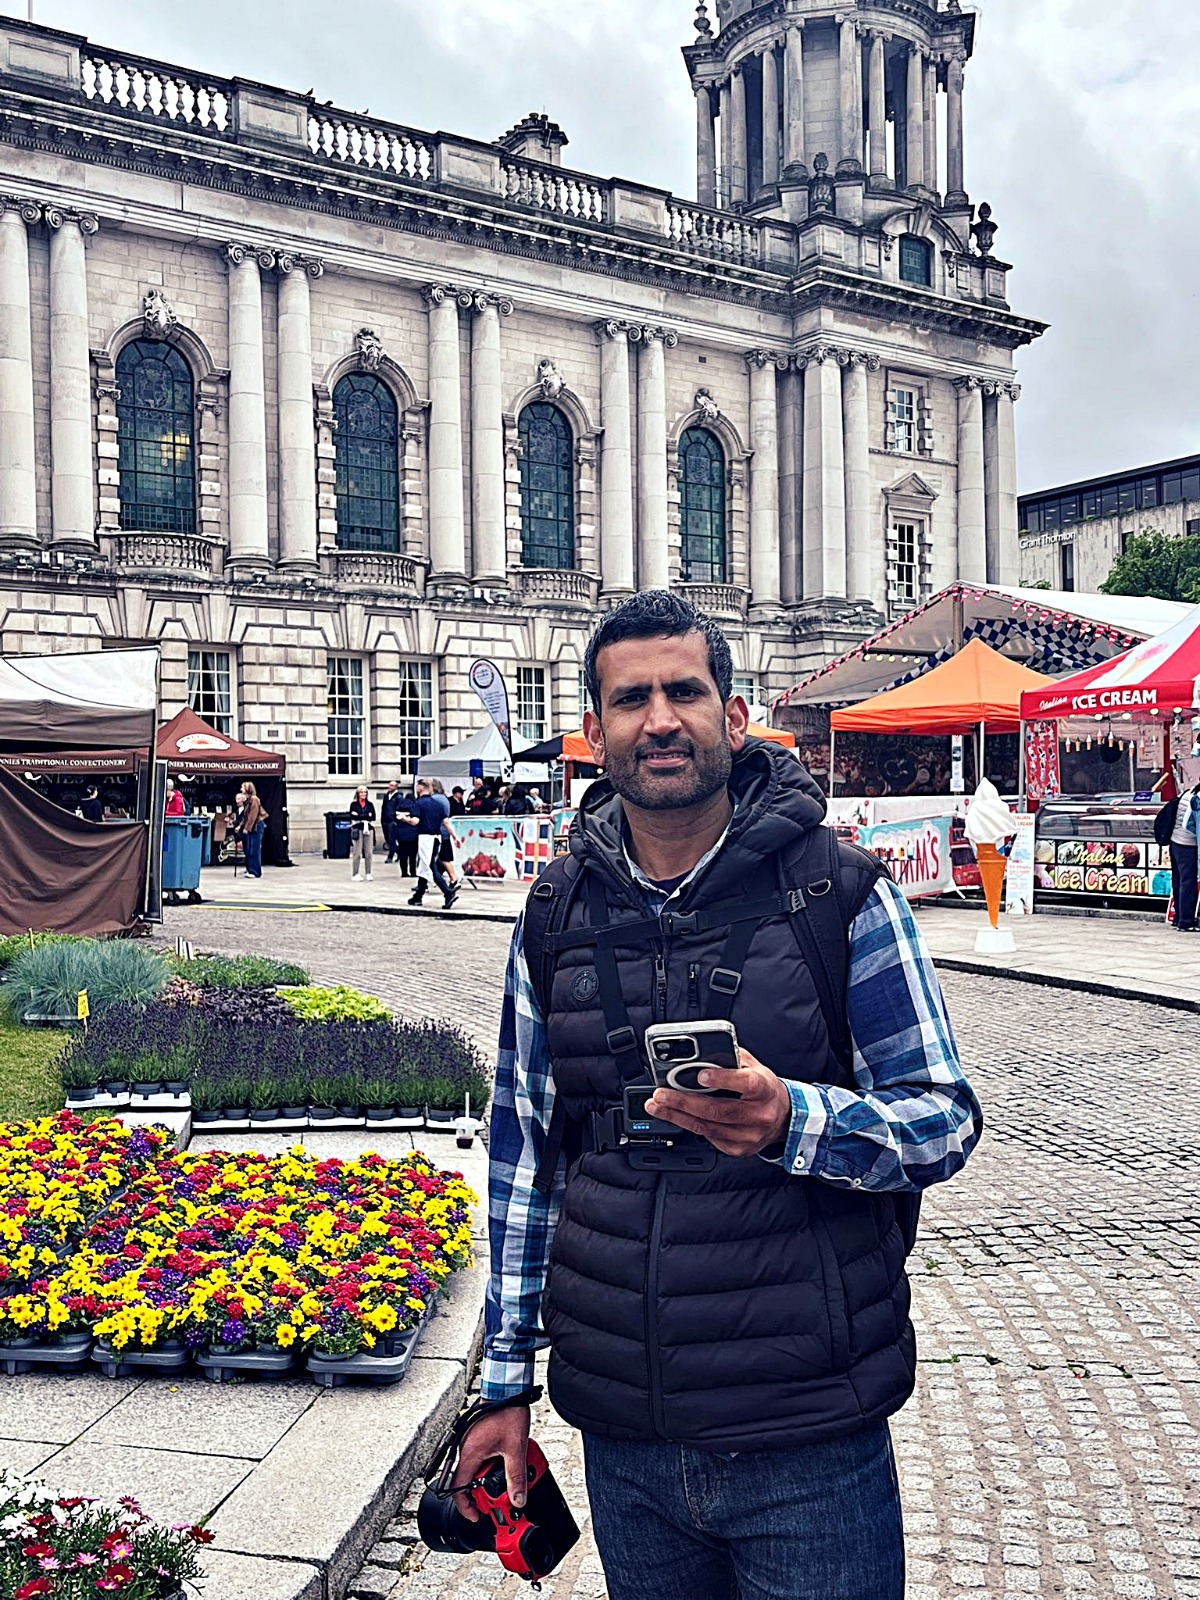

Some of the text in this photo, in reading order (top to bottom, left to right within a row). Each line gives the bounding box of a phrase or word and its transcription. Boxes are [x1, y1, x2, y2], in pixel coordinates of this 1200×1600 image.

[1039, 689, 1157, 711] Italian ICE CREAM
[185, 761, 227, 769] TRADITIONAL
[229, 762, 280, 770] CONFECTIONERY
[1074, 844, 1126, 866] Italian
[1054, 866, 1083, 890] Ice
[1085, 866, 1149, 893] Cream
